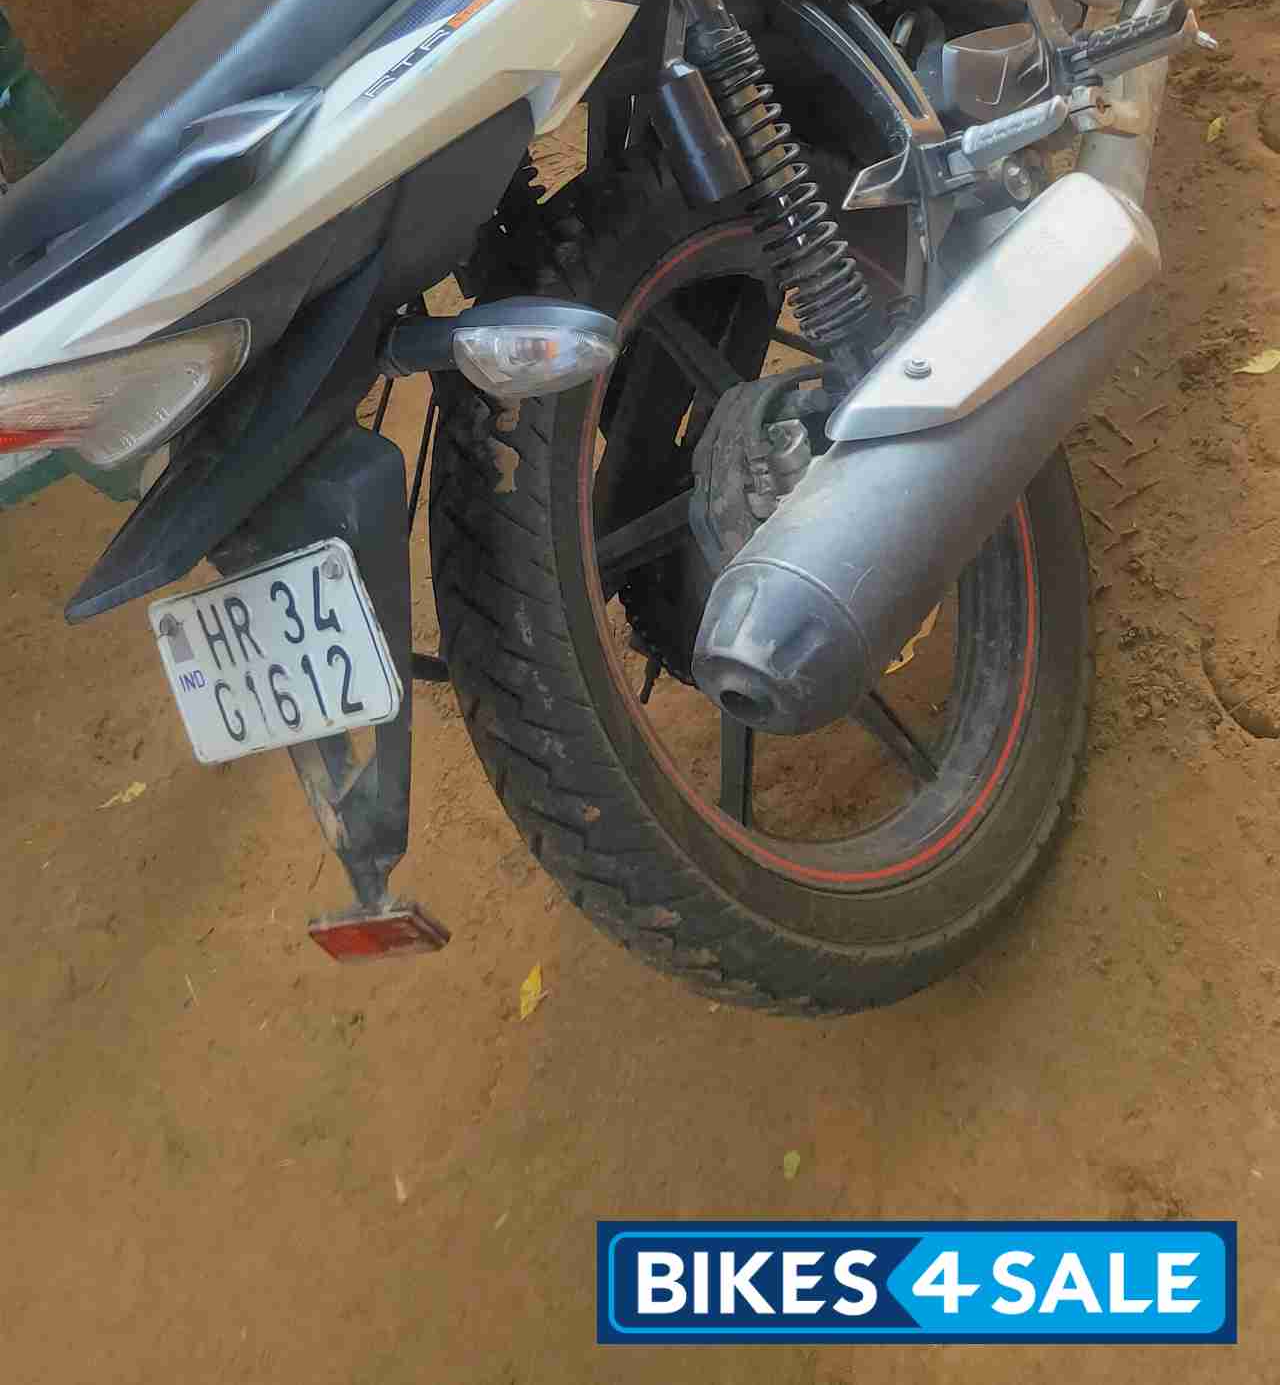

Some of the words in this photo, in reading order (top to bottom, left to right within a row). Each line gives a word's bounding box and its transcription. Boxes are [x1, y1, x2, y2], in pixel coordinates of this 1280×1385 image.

[197, 597, 265, 670] HR
[270, 566, 342, 644] 34
[178, 669, 206, 693] IND
